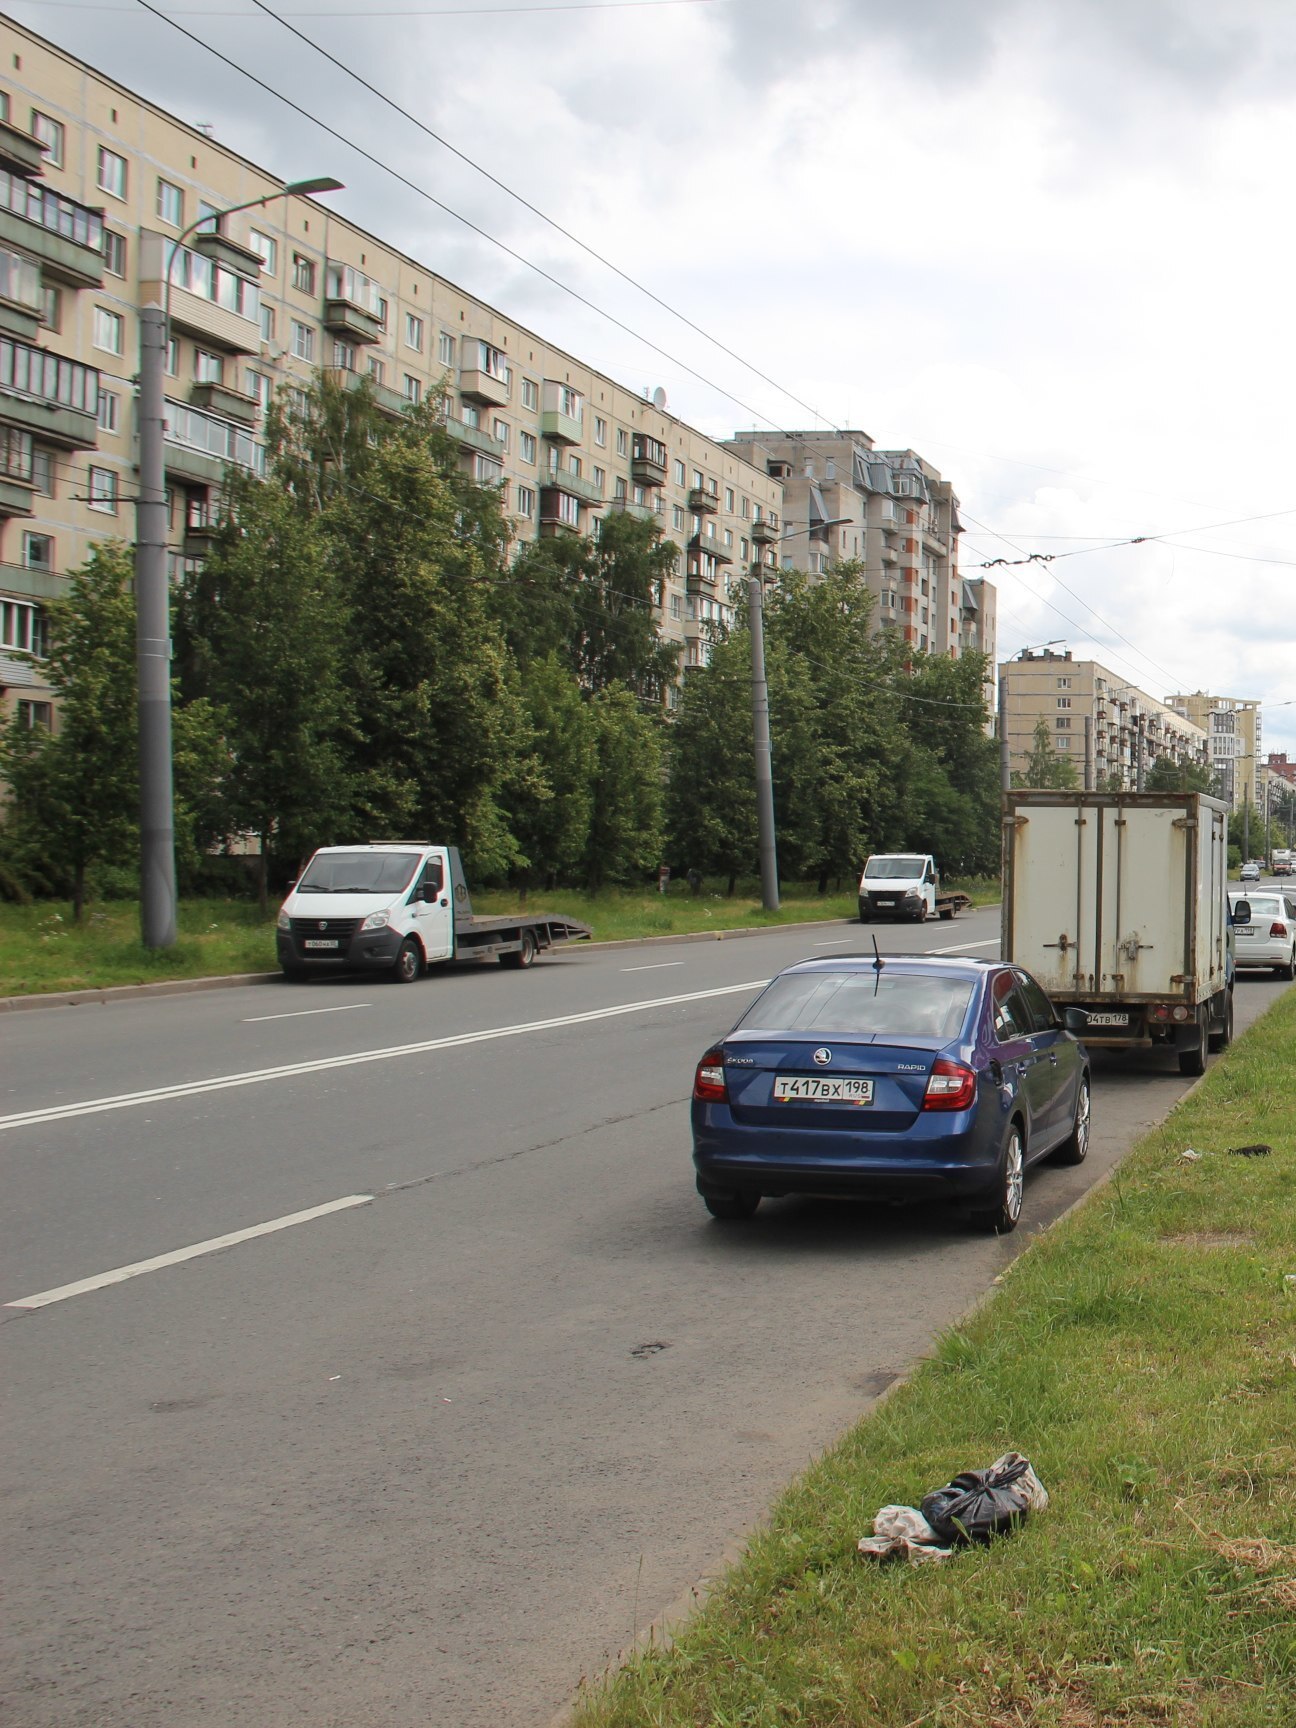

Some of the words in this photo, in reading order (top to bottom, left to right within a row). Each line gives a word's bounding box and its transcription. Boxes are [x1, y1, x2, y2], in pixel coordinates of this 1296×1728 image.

[1112, 1014, 1127, 1022] 178
[897, 1063, 926, 1071] RAPID
[780, 1079, 842, 1097] Т417ВХ
[845, 1080, 869, 1094] 198
